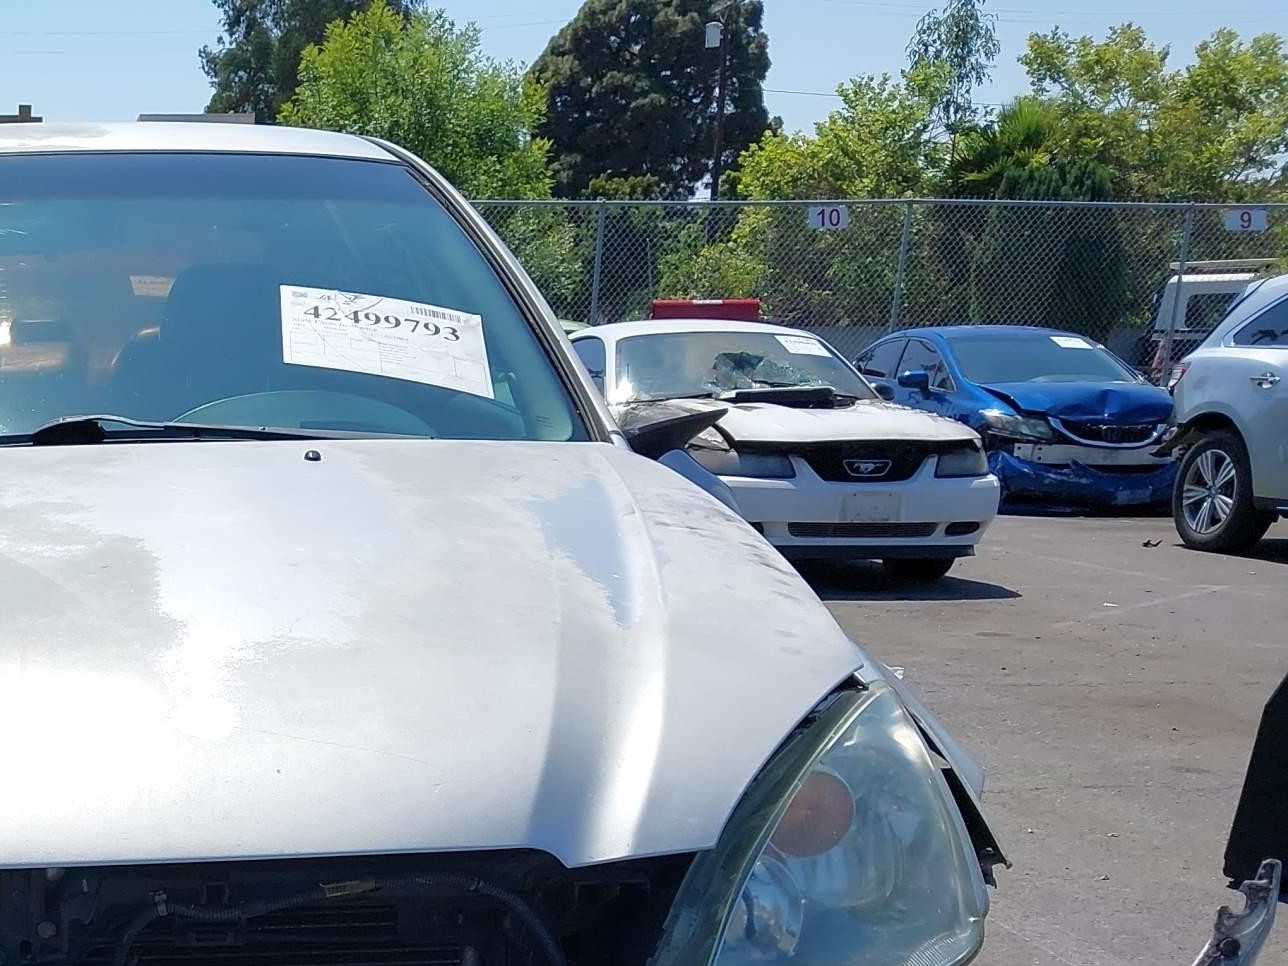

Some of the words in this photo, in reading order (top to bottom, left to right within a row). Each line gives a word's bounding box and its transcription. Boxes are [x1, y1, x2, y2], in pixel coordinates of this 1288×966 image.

[816, 208, 841, 227] 10
[1239, 210, 1252, 229] 9
[303, 304, 461, 342] 42499793
